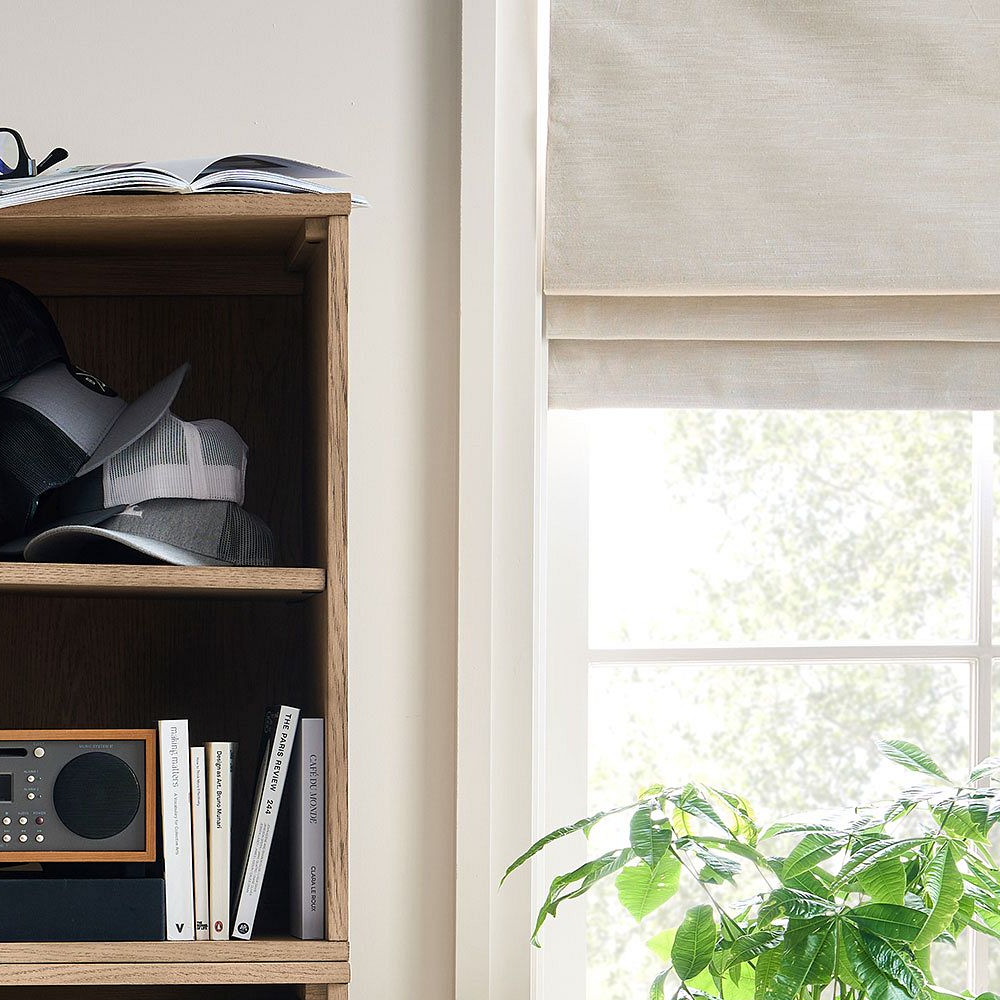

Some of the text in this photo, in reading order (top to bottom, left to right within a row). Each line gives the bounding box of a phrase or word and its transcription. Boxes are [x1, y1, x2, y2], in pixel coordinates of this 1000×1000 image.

[282, 713, 292, 730] THE
[276, 732, 288, 757] PARIS
[215, 750, 223, 770] Design
[309, 754, 319, 777] CAFÉ
[270, 759, 282, 792] REVIEW
[309, 791, 318, 824] MONDE
[175, 923, 185, 933] V
